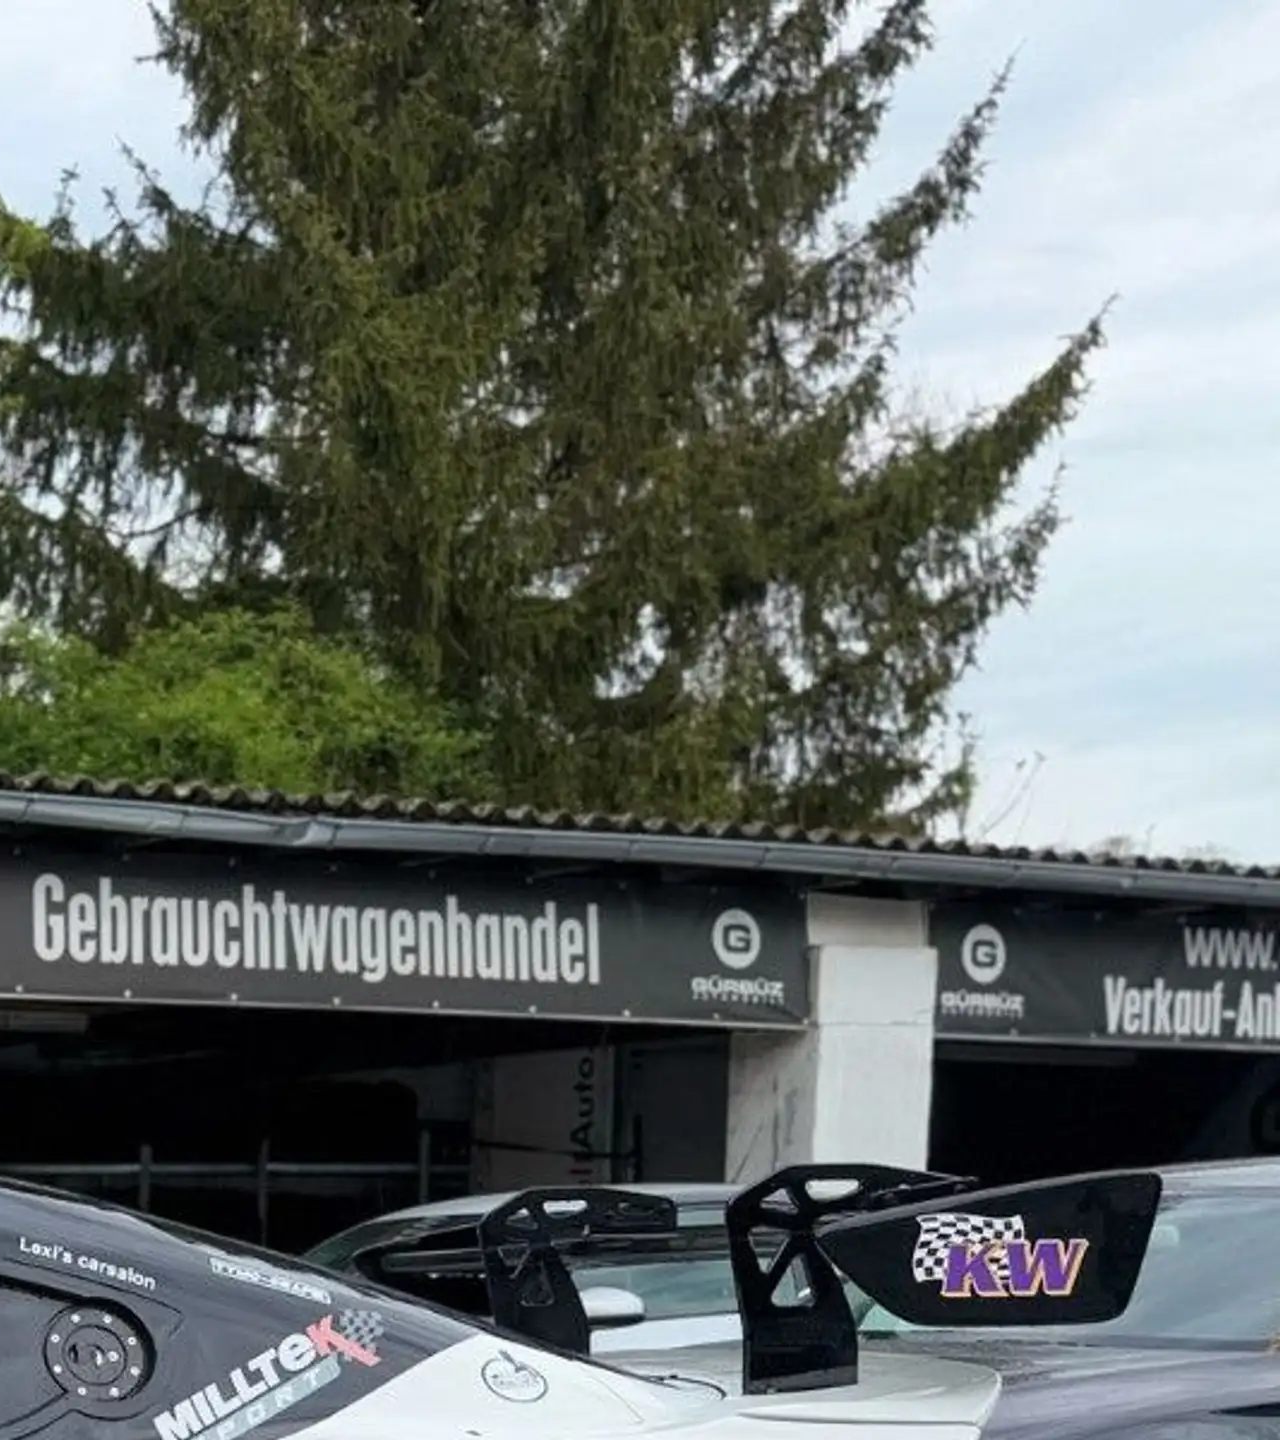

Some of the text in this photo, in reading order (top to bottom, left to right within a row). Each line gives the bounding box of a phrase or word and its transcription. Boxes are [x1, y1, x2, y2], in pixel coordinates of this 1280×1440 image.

[32, 873, 600, 984] Gebrauchtwagenhandel
[77, 1253, 157, 1291] carsalon
[940, 1238, 1090, 1297] KW
